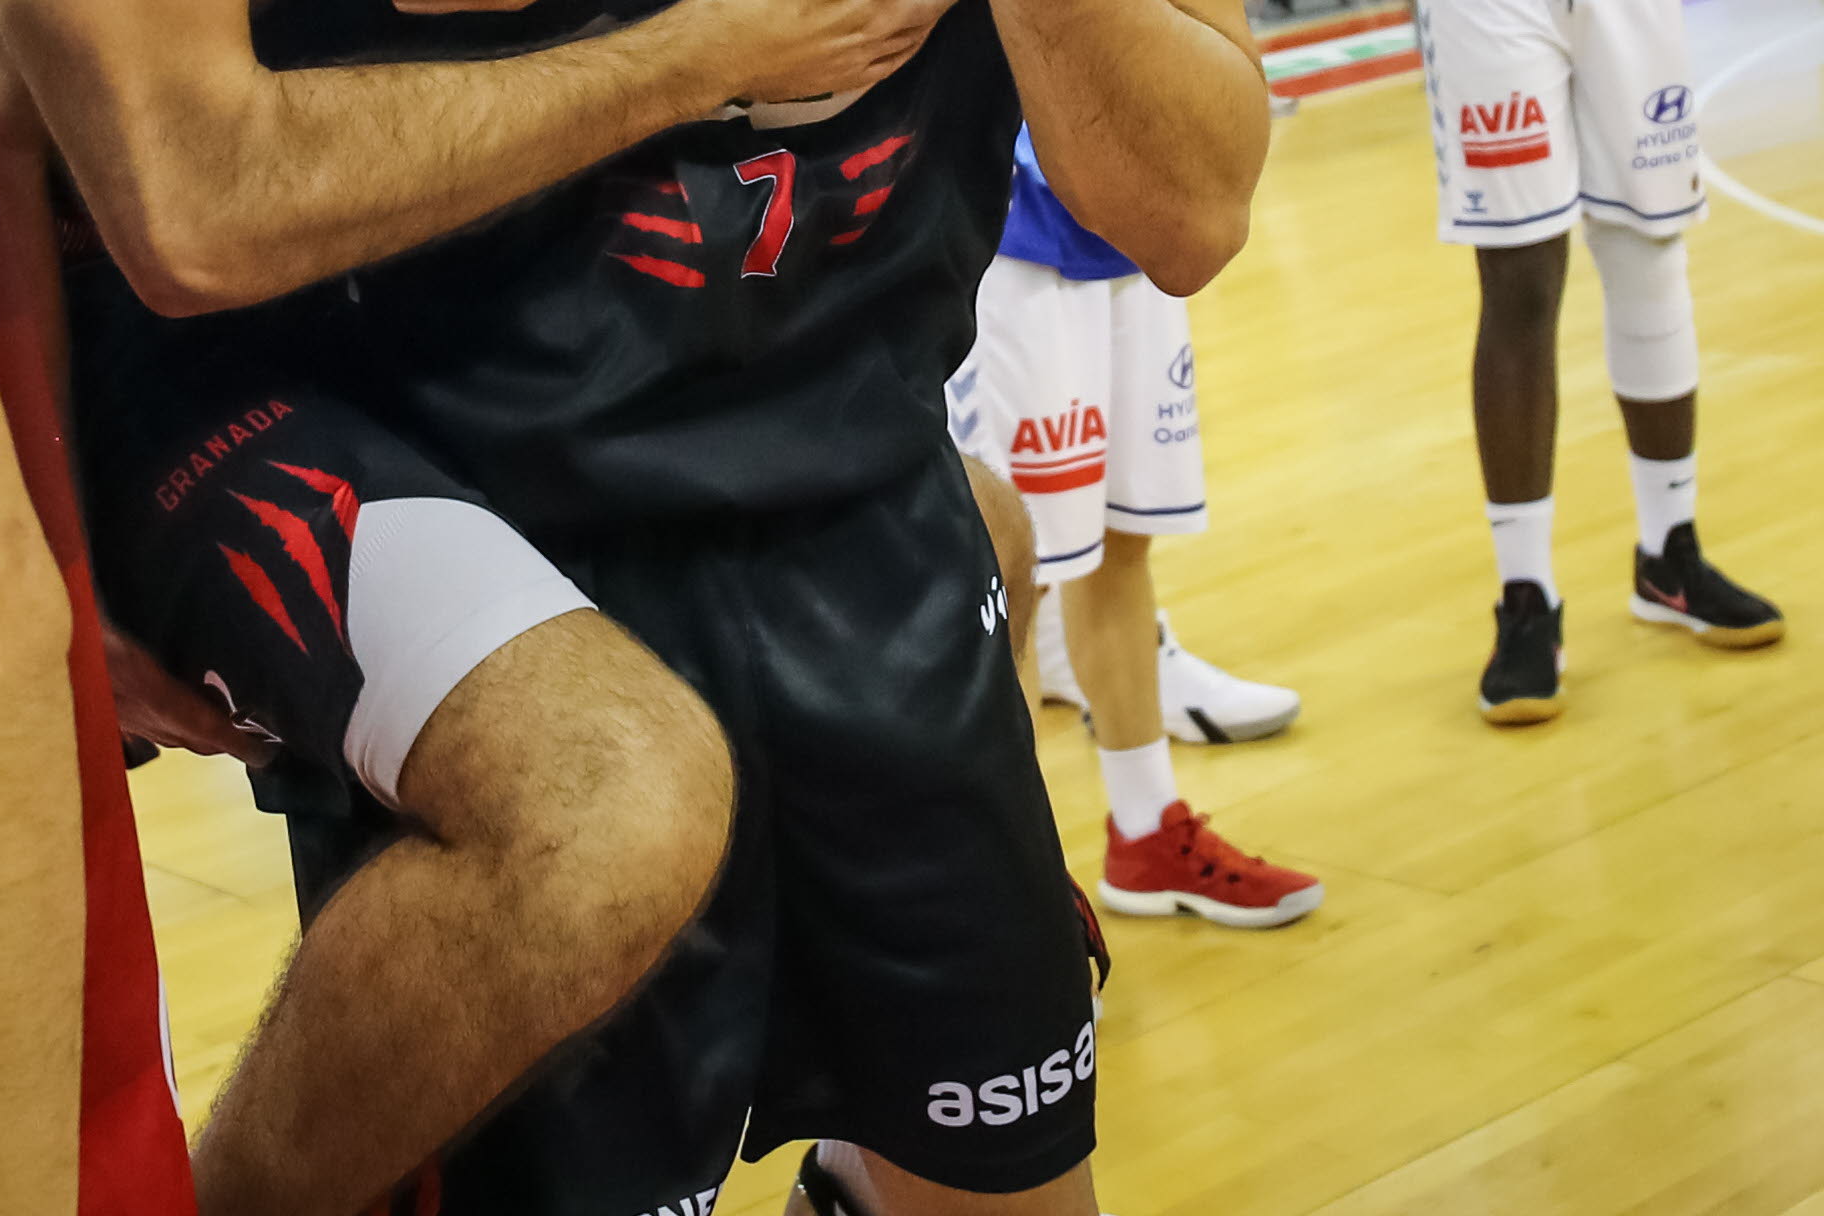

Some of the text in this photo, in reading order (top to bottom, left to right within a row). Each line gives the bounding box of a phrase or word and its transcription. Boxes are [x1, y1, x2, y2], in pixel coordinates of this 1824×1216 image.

[733, 148, 795, 278] 7
[155, 400, 293, 512] GRANADA
[980, 575, 1008, 635] vi
[927, 1020, 1095, 1127] asisa
